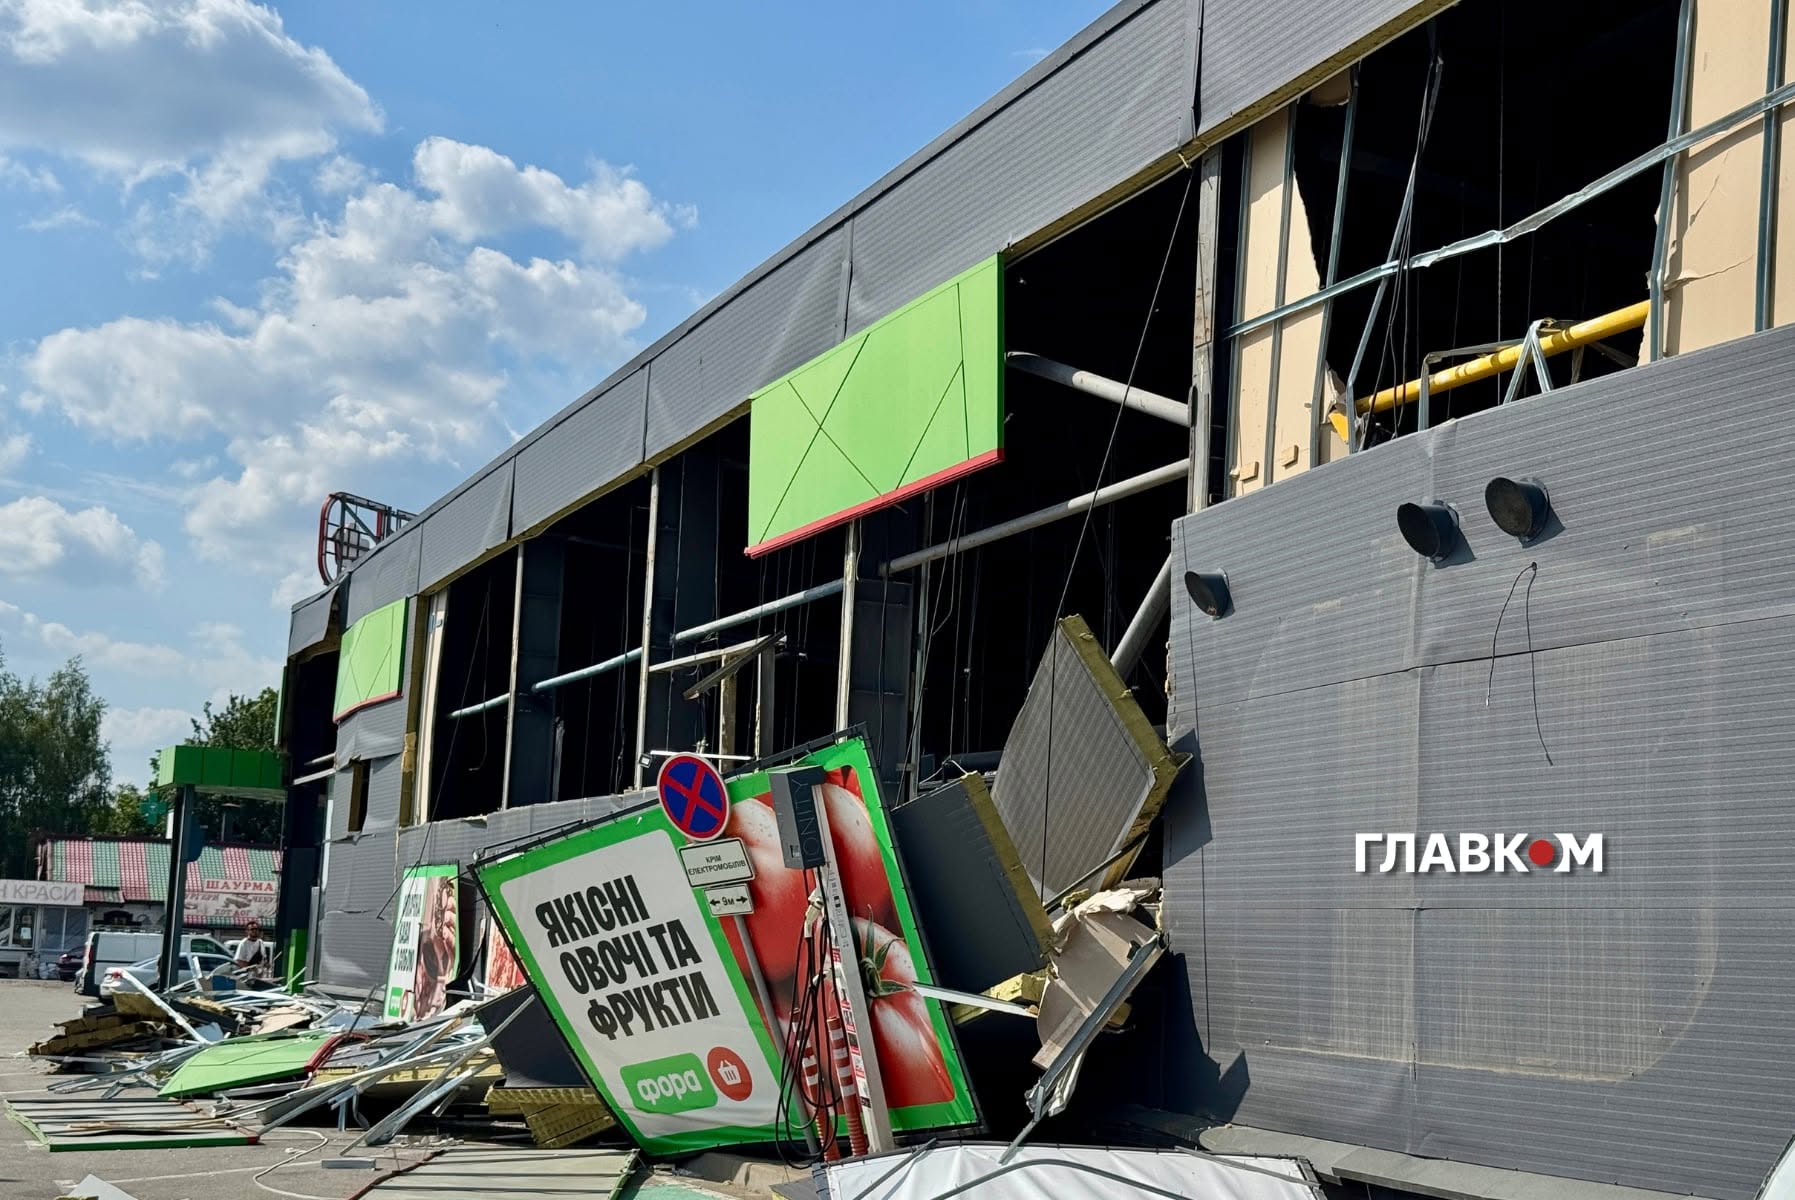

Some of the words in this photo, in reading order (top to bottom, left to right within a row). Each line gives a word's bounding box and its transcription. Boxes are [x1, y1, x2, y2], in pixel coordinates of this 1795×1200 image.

[792, 778, 823, 862] IONITY
[688, 859, 747, 876] ЕЛЕКТРОМОБІЛІВ
[705, 854, 722, 863] КРІМ
[14, 884, 77, 902] КРАСИ
[206, 880, 273, 892] ШАУРМА
[535, 874, 650, 948] ЯКІСНІ
[559, 930, 659, 995] ОВОЧІ
[646, 918, 702, 971] ТА
[587, 970, 721, 1041] ФРУКТИ
[637, 1068, 703, 1105] фора
